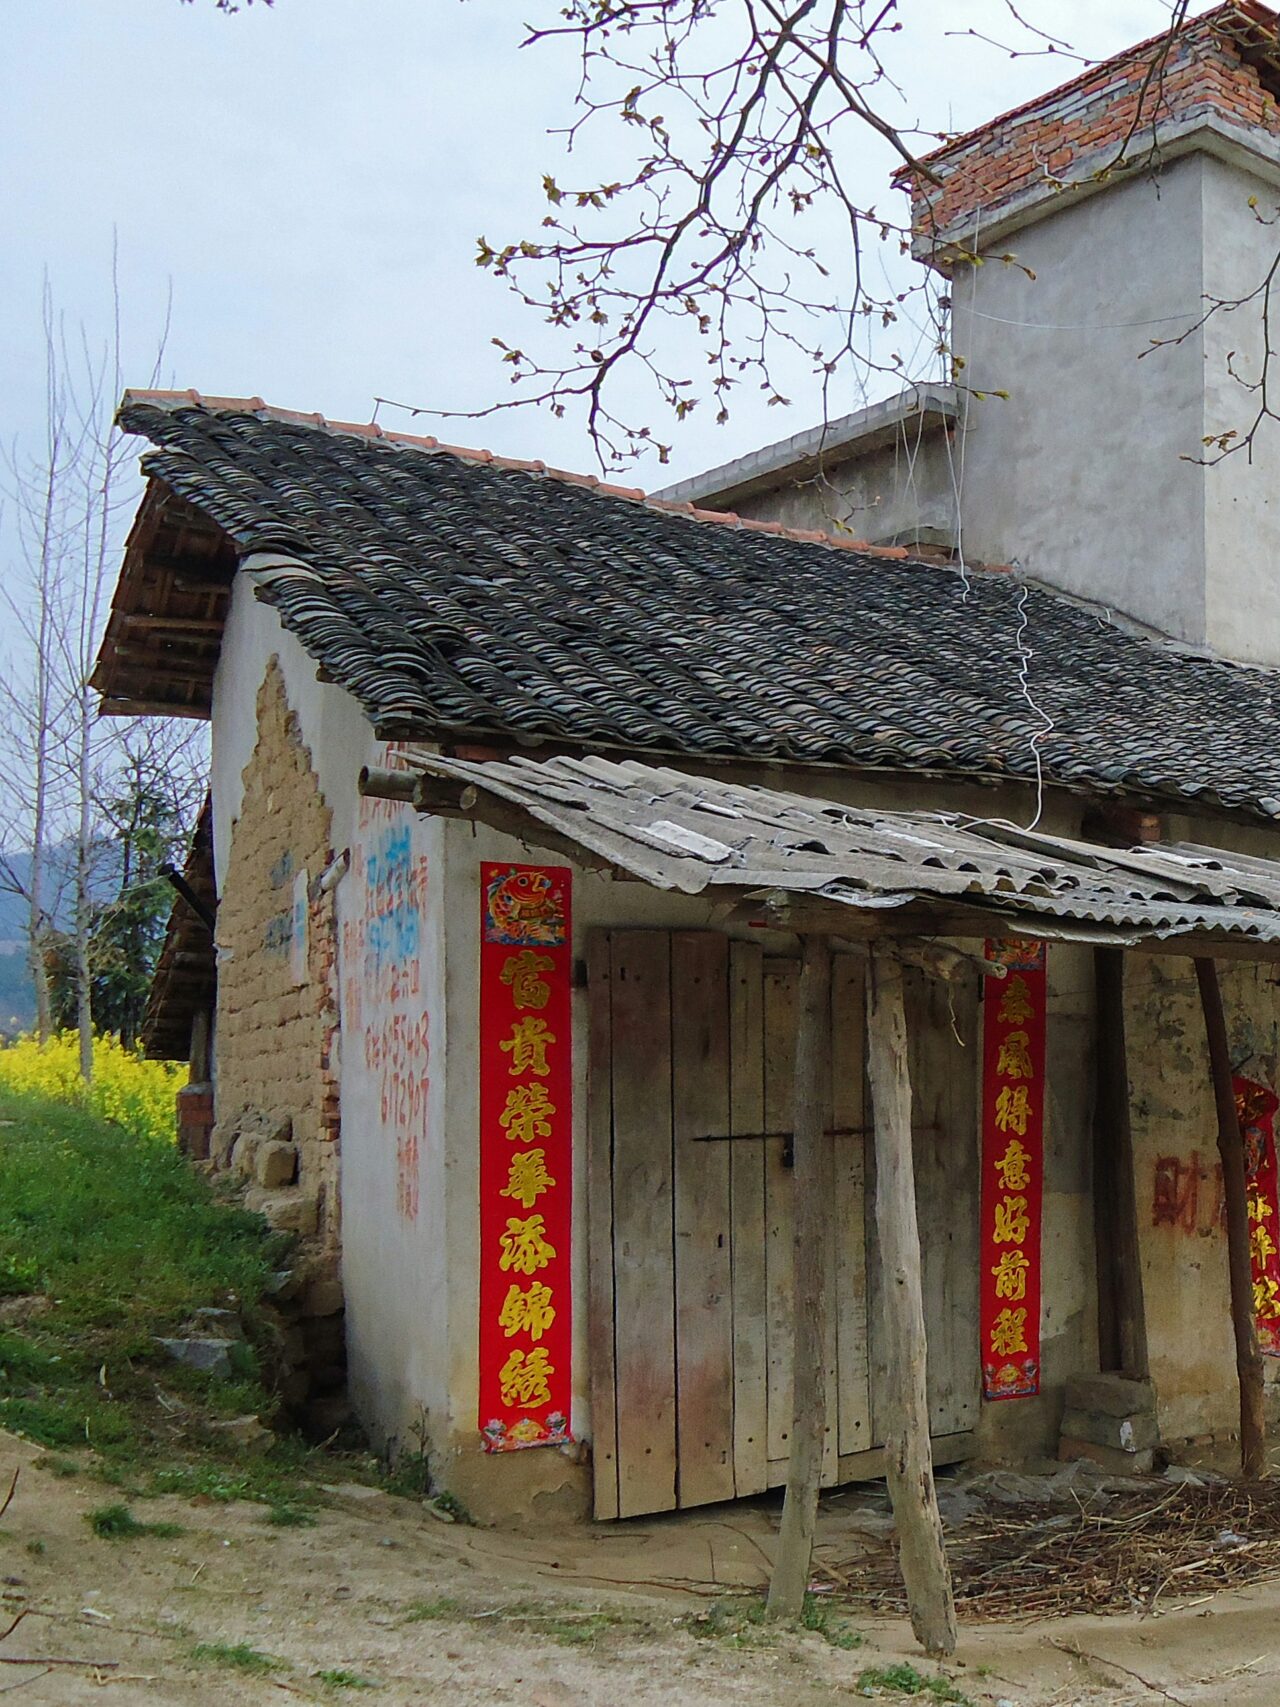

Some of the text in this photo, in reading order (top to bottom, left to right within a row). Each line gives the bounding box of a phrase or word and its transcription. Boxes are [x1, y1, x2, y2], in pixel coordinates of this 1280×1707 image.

[989, 974, 1035, 1358] 春風得意好前程
